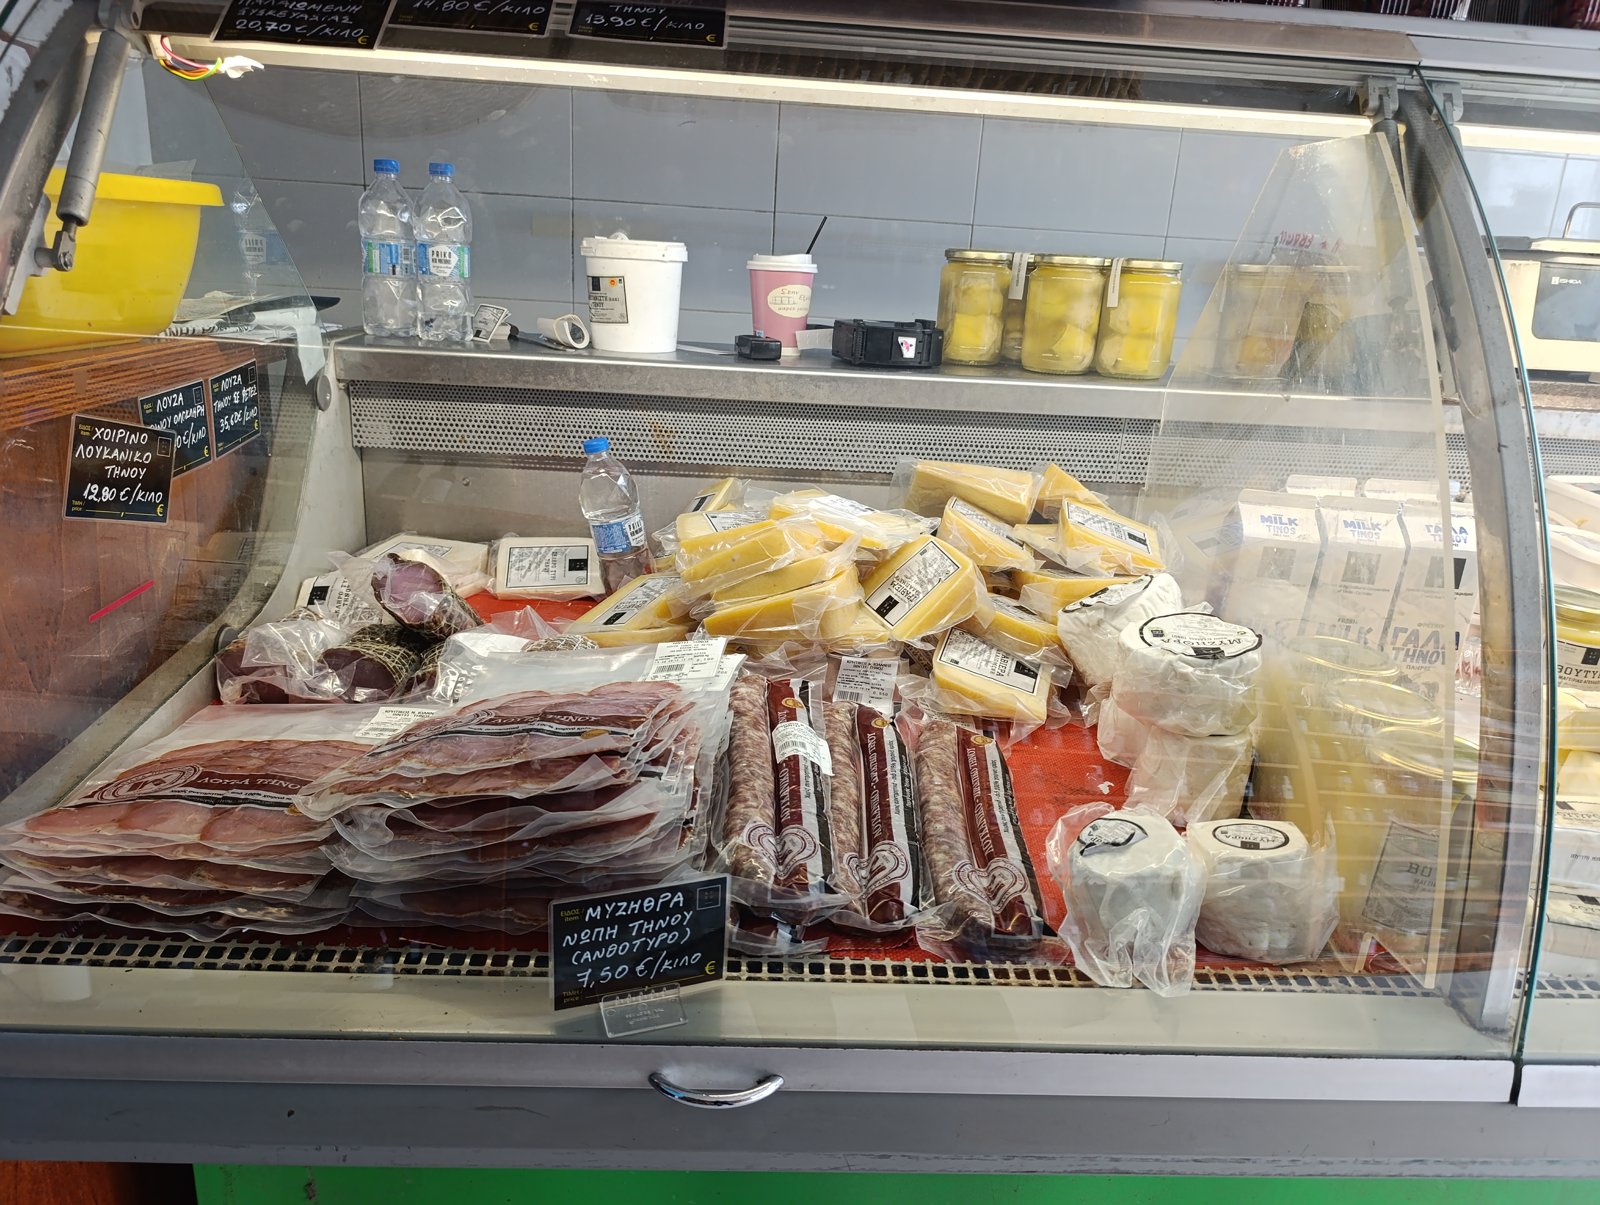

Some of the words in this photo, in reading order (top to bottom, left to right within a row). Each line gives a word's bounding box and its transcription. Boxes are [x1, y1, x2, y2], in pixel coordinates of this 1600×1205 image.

[156, 392, 184, 413] ΛΟΥΖΑ
[92, 427, 149, 445] ΧΟΙΡΙΝΟ
[75, 444, 152, 464] ΛΟΥΚΑΝΙΚΟ
[105, 464, 147, 479] ΤΗΝΟΥ
[83, 482, 116, 502] 12,80
[1260, 513, 1299, 526] MILK
[1266, 524, 1296, 535] TINOS
[1343, 519, 1383, 532] MILK
[256, 778, 301, 790] ΤΗΝΟ
[585, 891, 684, 922] ΜΥΖΗΘΡΑ
[562, 924, 618, 947] ΝΩΠΗ
[628, 910, 694, 936] ΤΗΝΟΥ
[571, 928, 691, 965] (ΑΝΘΟΤΥΡΟ)
[576, 965, 630, 988] 7,50
